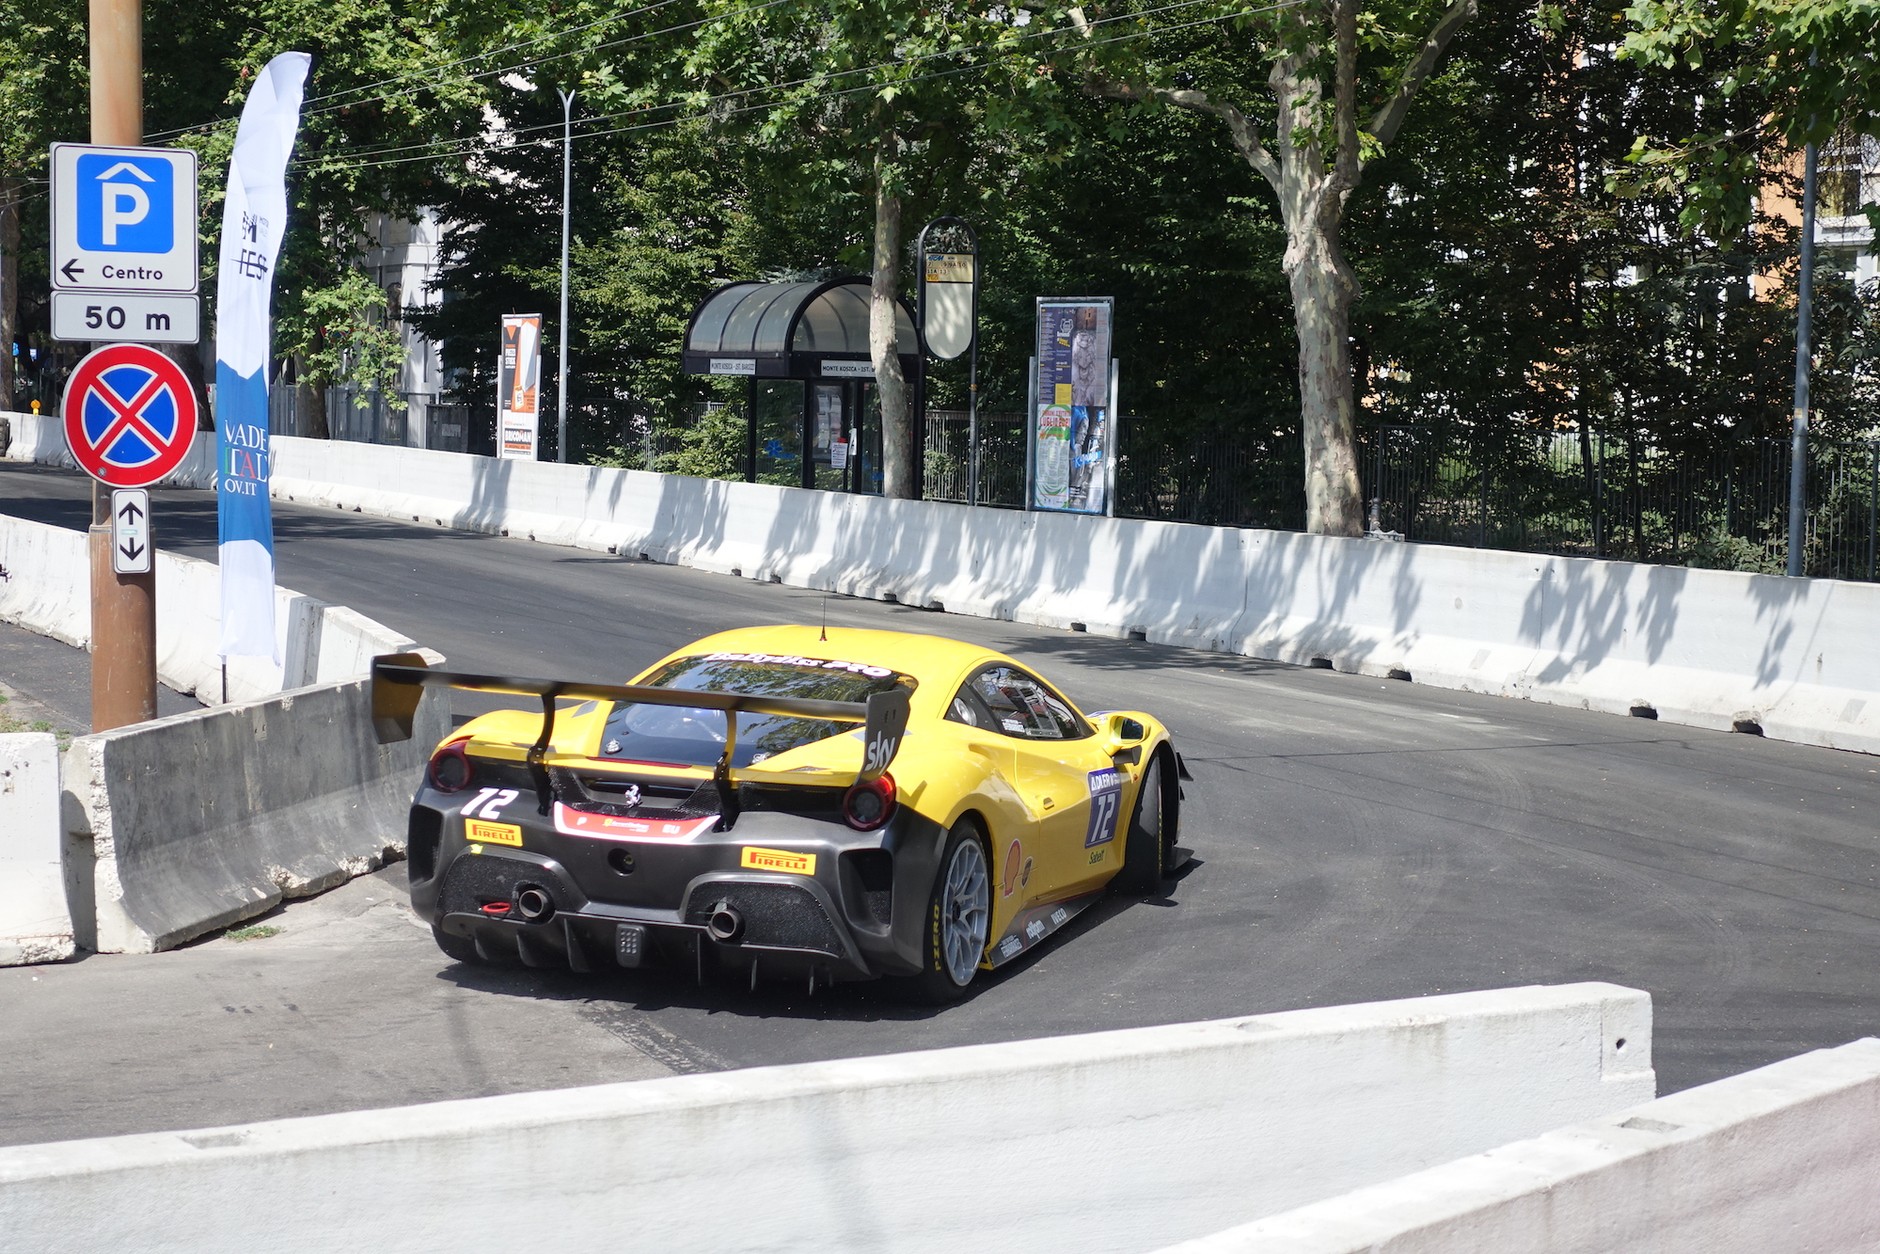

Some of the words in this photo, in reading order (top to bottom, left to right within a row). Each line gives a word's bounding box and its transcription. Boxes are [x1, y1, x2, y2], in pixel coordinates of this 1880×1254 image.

[102, 182, 150, 246] P
[102, 265, 163, 281] Centro
[85, 305, 126, 330] 50
[146, 313, 171, 331] m
[839, 365, 857, 373] KOSICA
[821, 660, 893, 678] PRO
[864, 730, 896, 776] sky
[472, 824, 516, 842] PIRELLI
[750, 851, 808, 870] PIRELLI
[1050, 907, 1068, 925] IVECO
